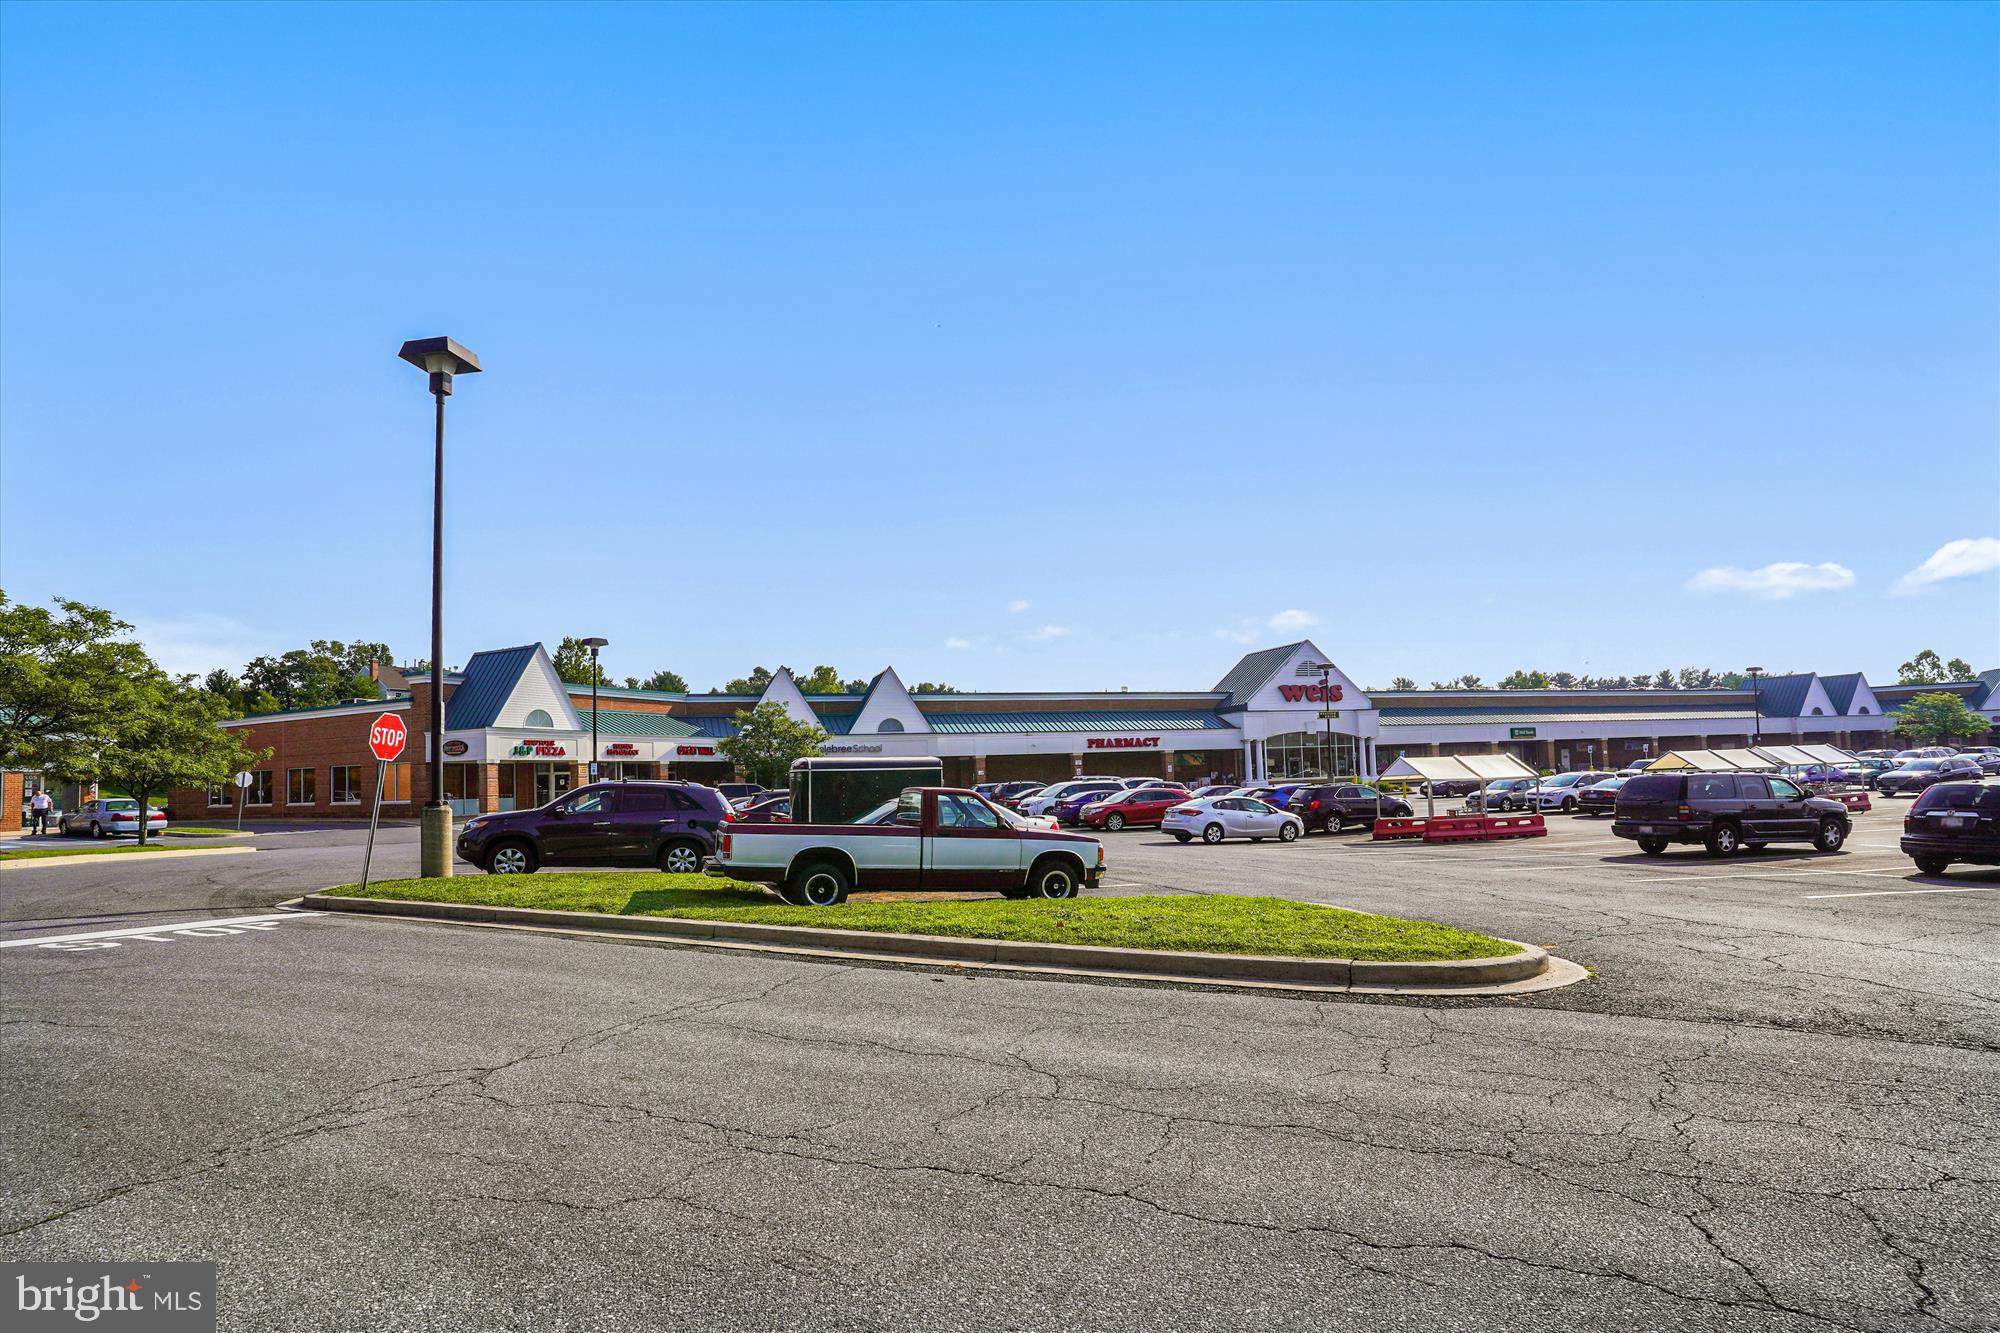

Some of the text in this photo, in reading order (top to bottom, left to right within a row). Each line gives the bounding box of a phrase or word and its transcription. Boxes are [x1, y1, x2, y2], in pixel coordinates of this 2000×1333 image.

[1278, 679, 1343, 702] weis
[373, 726, 404, 747] STOP
[1087, 737, 1160, 748] PHARMACY
[512, 745, 566, 756] J&P PIZZA
[38, 921, 281, 951] STOP
